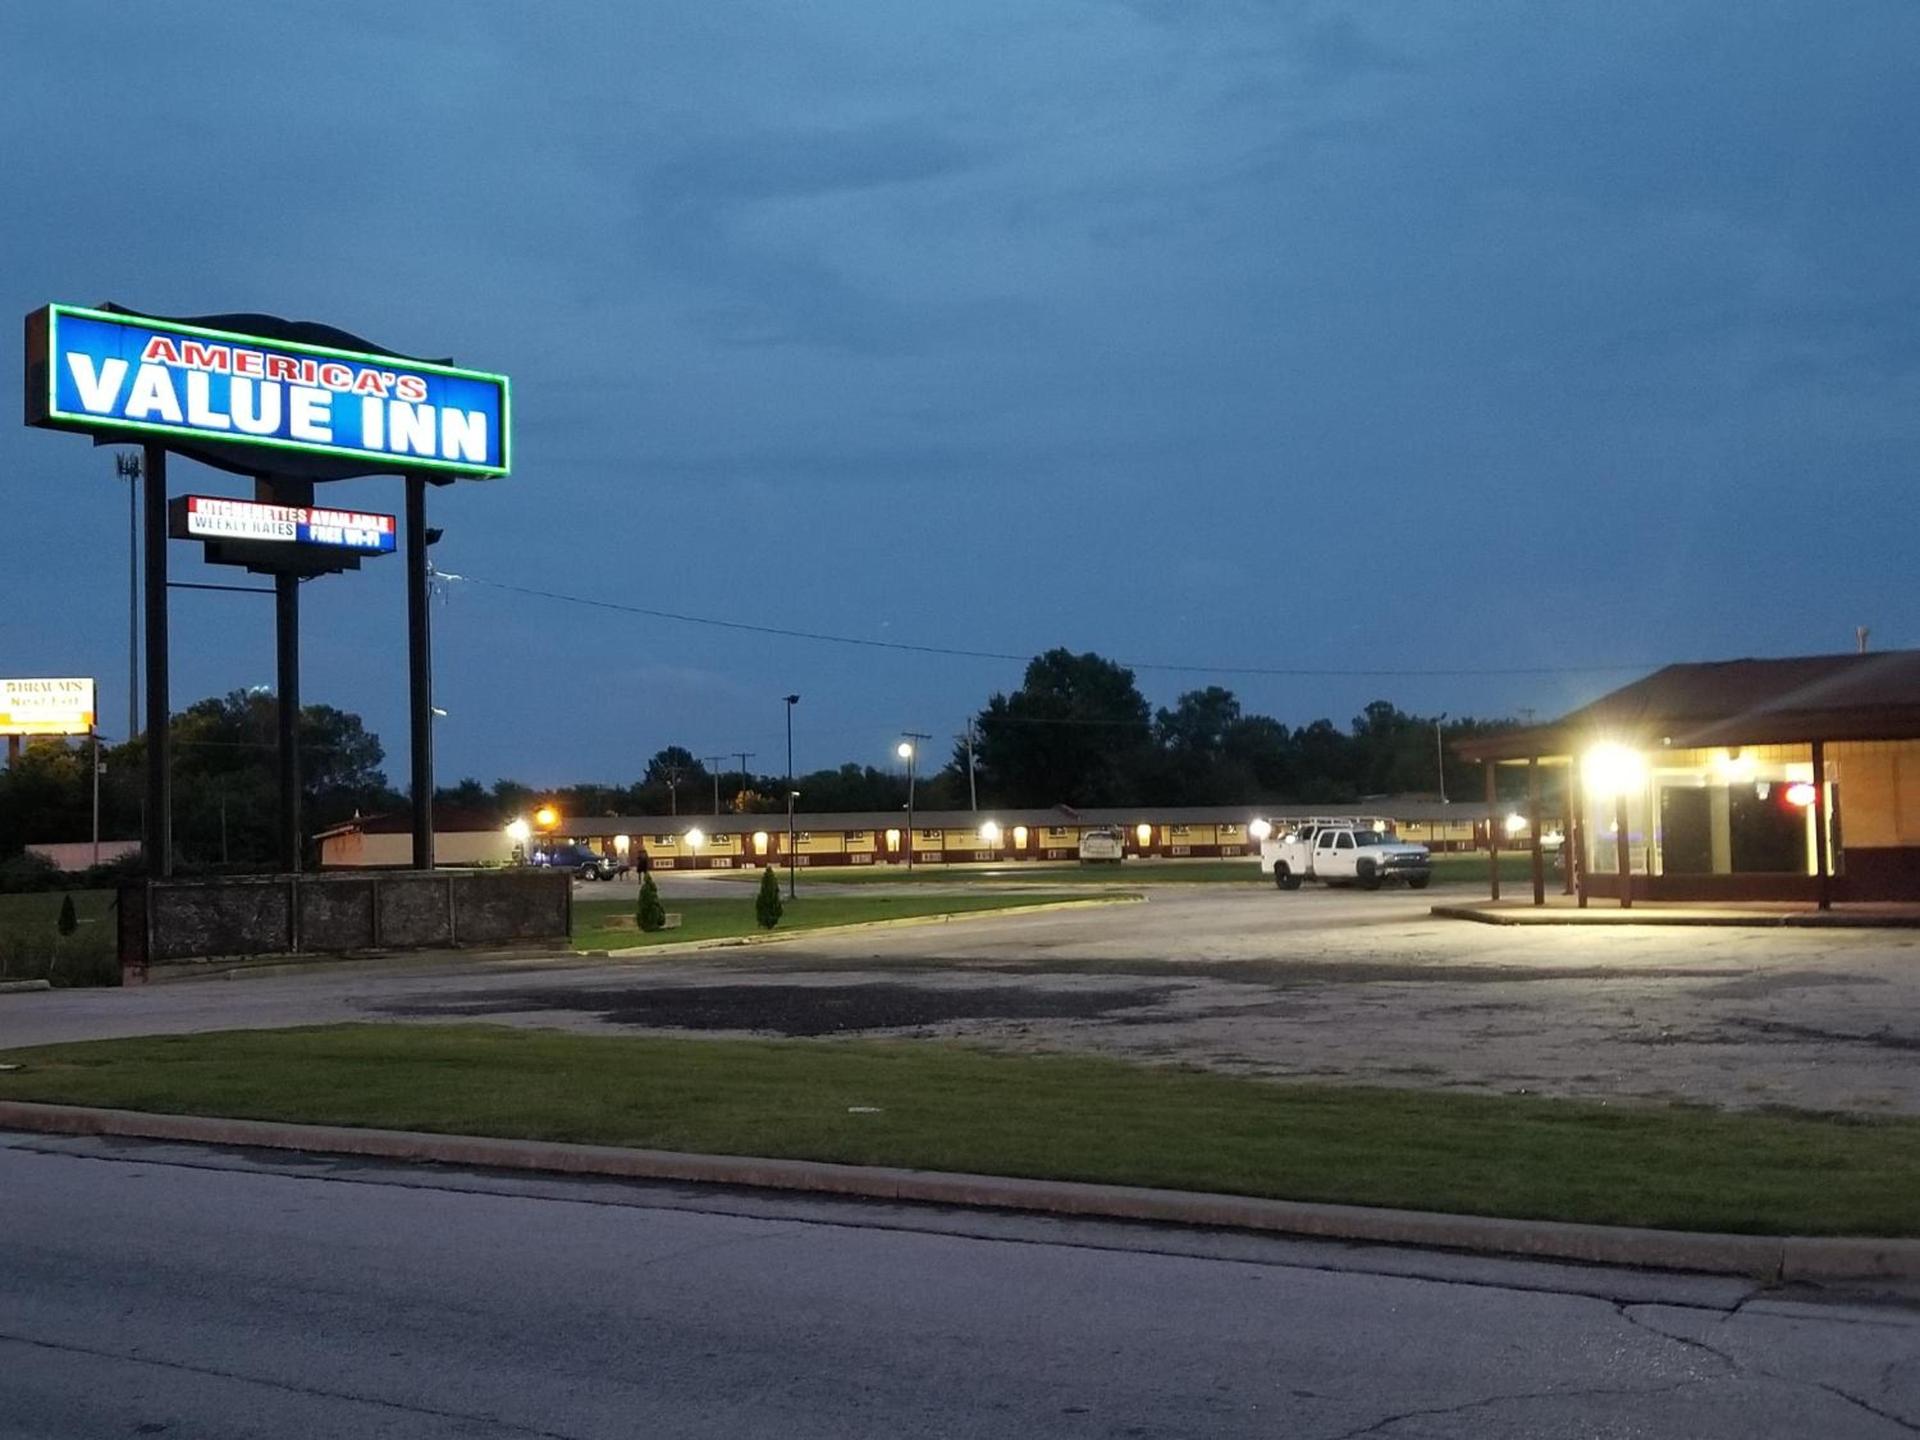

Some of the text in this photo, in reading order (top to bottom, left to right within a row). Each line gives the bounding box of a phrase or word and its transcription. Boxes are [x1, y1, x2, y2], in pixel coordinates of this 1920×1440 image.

[142, 335, 428, 402] AMERICA'S
[66, 352, 488, 463] VALUE INN
[194, 516, 294, 536] WEEKLY RATES
